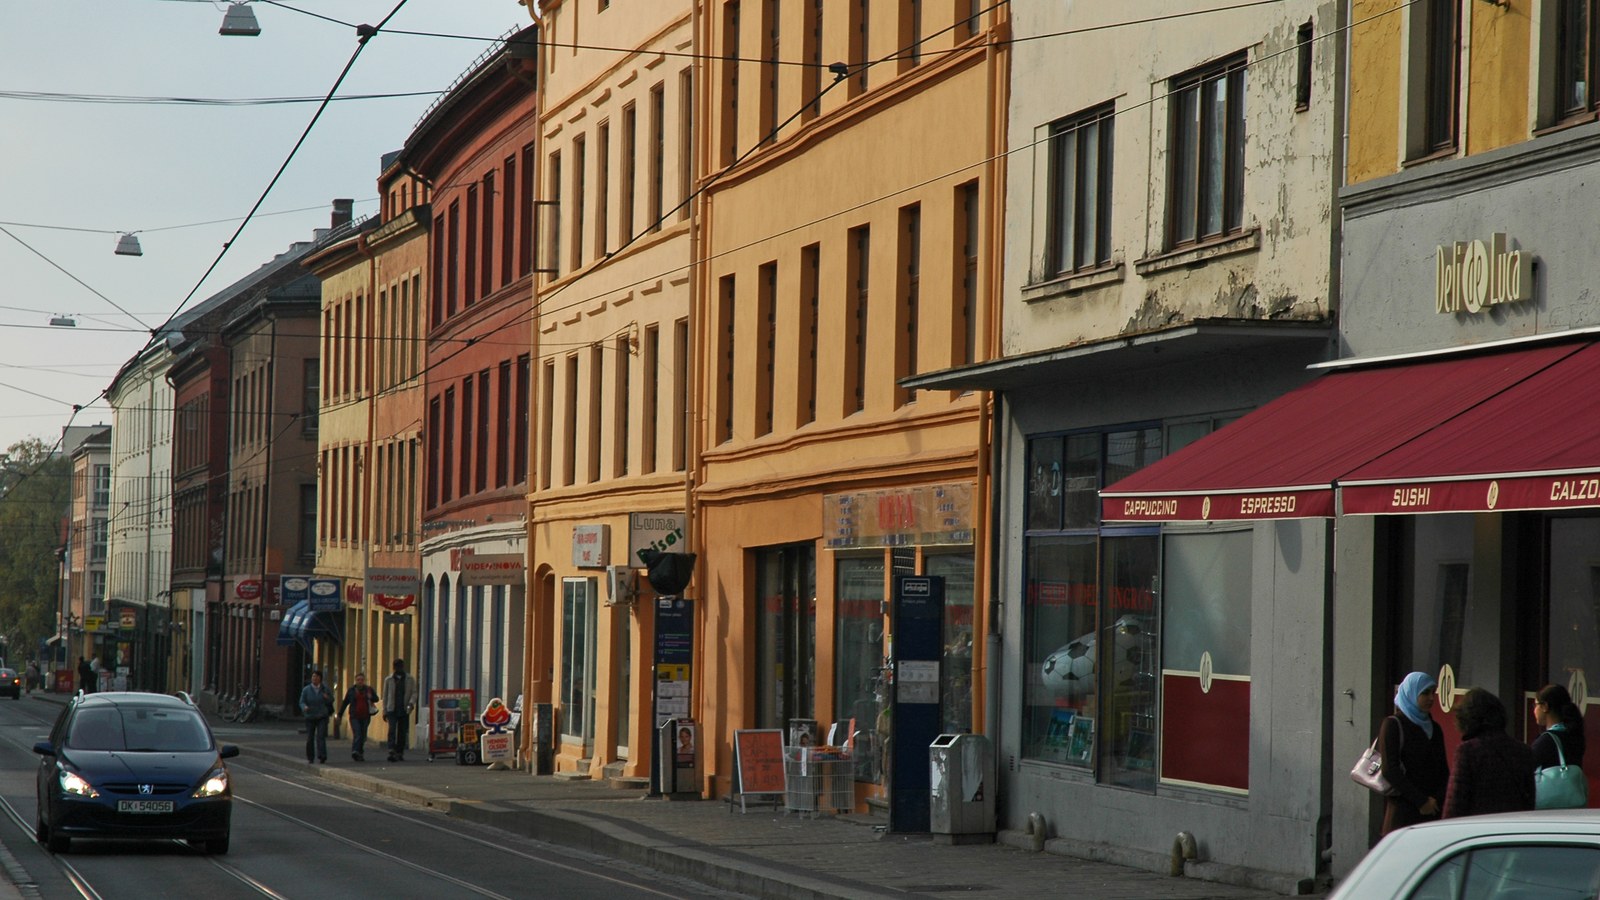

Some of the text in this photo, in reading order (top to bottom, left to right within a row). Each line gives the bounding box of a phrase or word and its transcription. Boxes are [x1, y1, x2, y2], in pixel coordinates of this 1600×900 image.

[1436, 231, 1520, 314] Deli de Luca
[1392, 488, 1431, 506] SUSHI
[1550, 479, 1600, 500] CALZO
[1124, 500, 1177, 516] CAPPUCCINO
[1240, 496, 1297, 514] ESPRESSO
[633, 514, 676, 531] Luna
[121, 801, 171, 811] DK 54056
